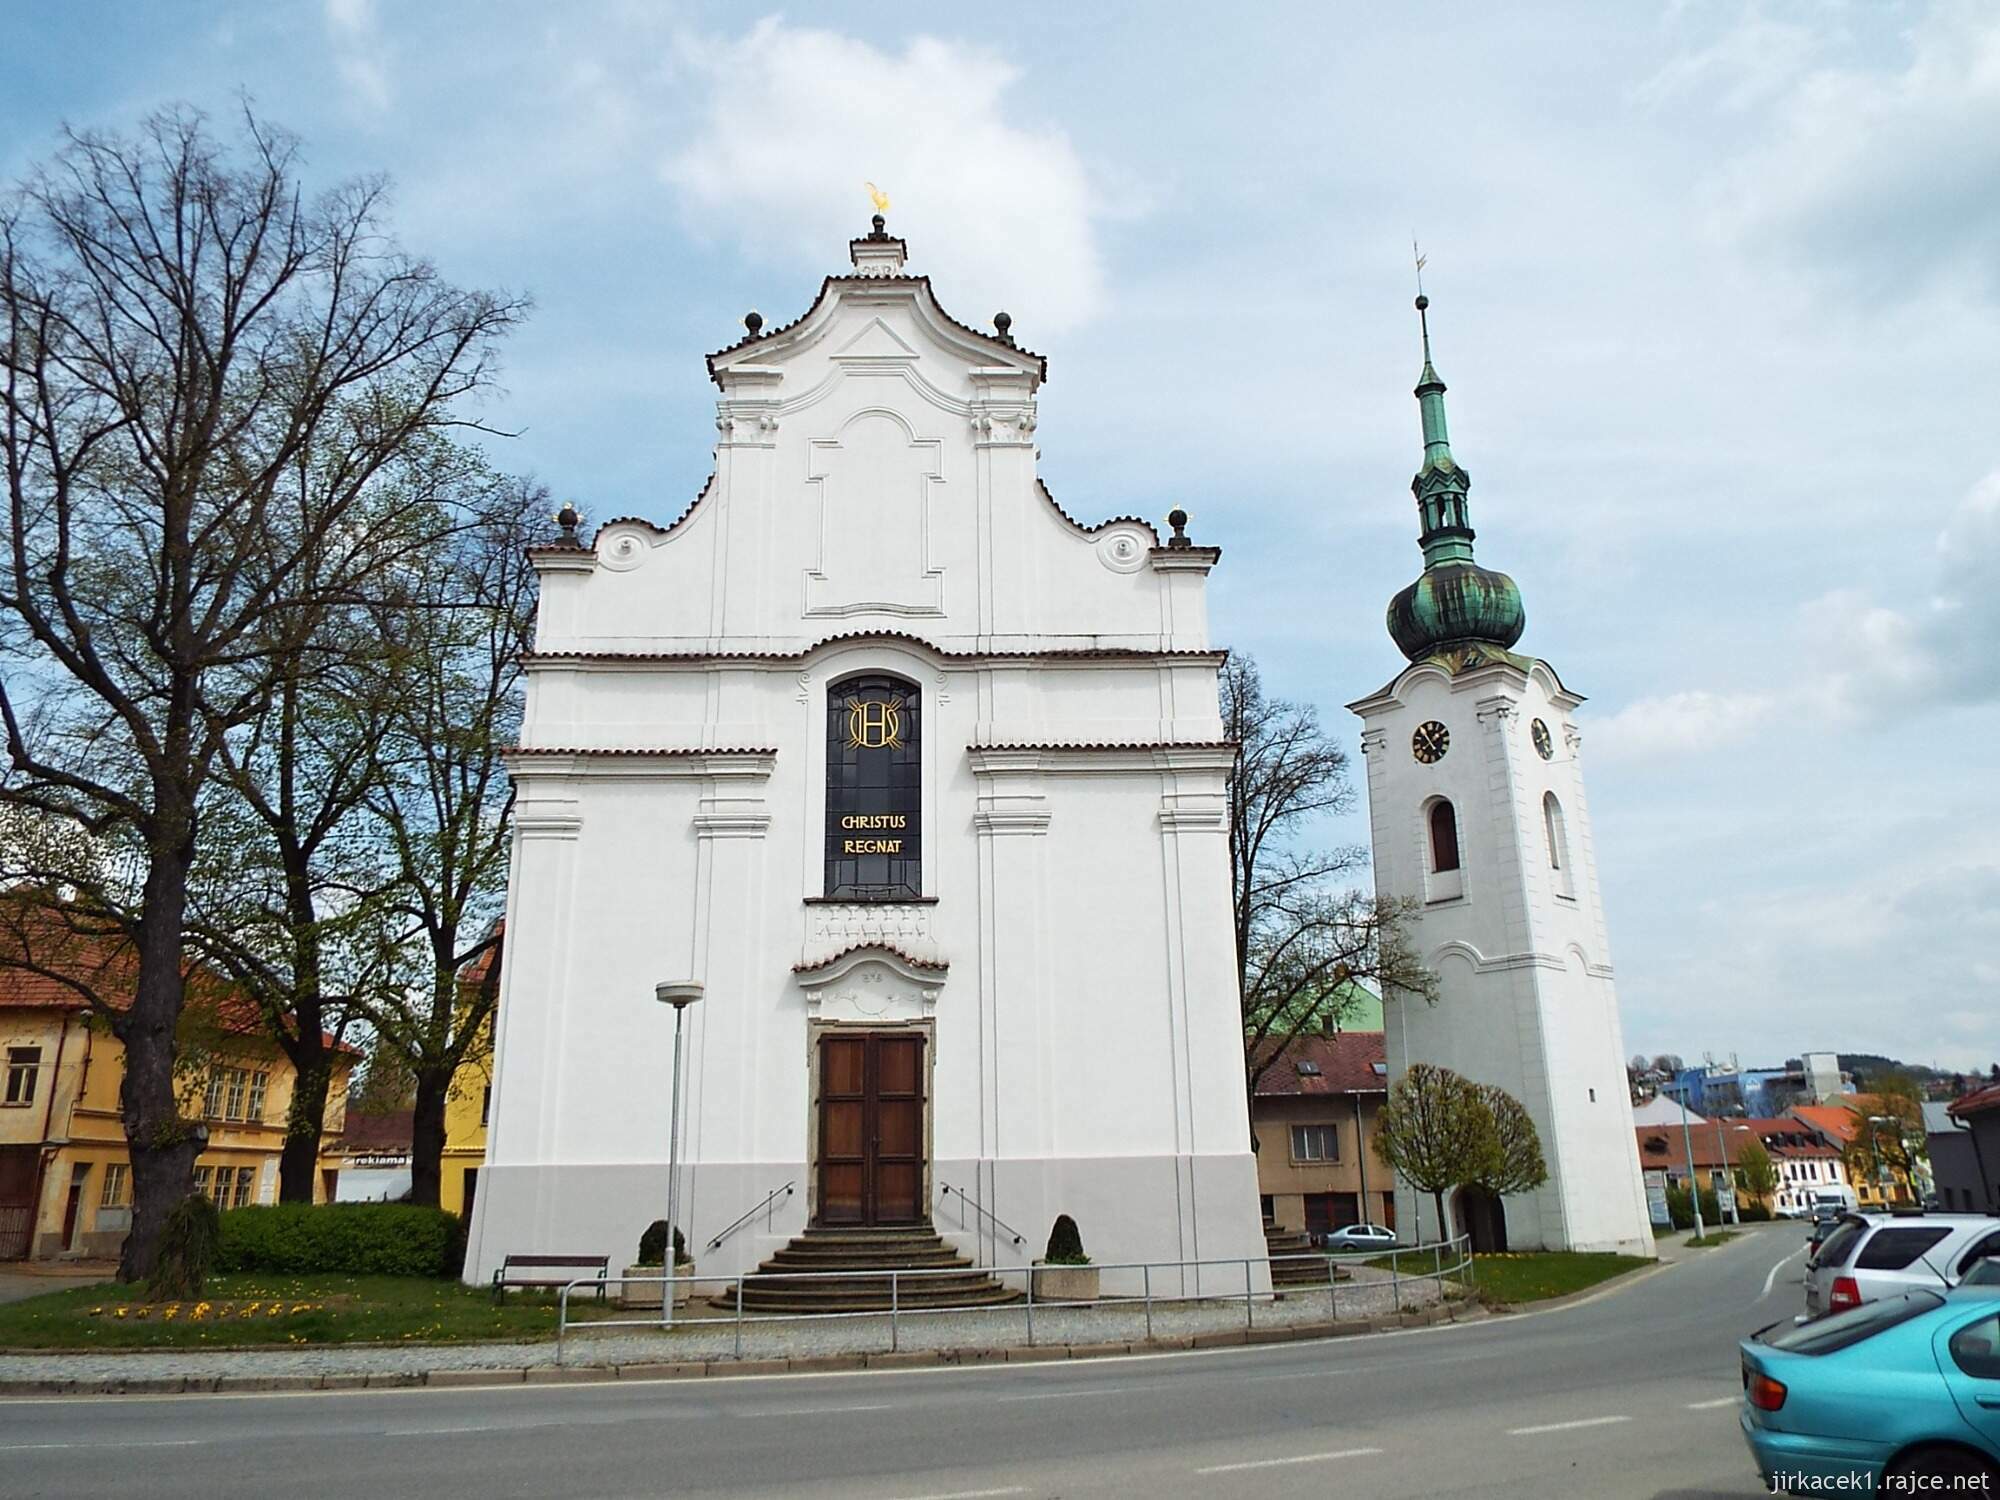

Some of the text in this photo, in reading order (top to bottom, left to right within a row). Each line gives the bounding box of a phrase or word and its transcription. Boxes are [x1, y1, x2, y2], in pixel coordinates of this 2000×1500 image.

[841, 815, 906, 829] CHRISTUS
[844, 840, 902, 854] REGNAT
[355, 1155, 405, 1165] reklama
